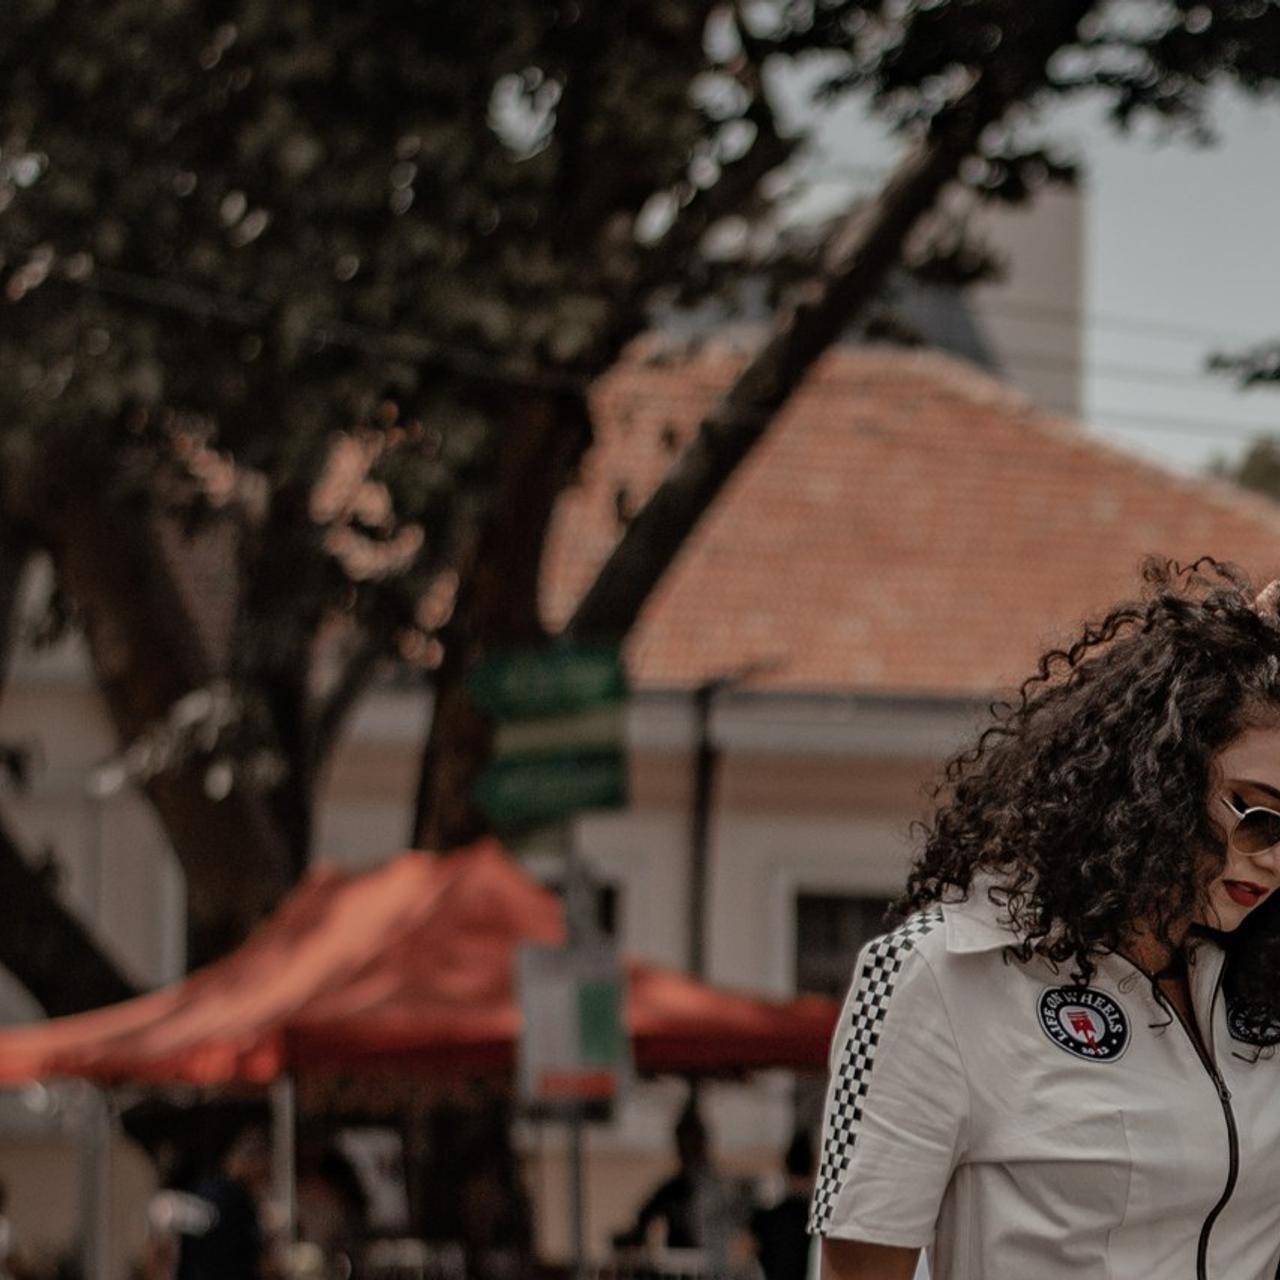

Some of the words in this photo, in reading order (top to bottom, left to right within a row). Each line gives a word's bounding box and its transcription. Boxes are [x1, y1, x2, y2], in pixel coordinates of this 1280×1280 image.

[1046, 992, 1064, 1009] ON
[1062, 992, 1123, 1033] WHEELS
[1044, 1007, 1068, 1040] LIFE
